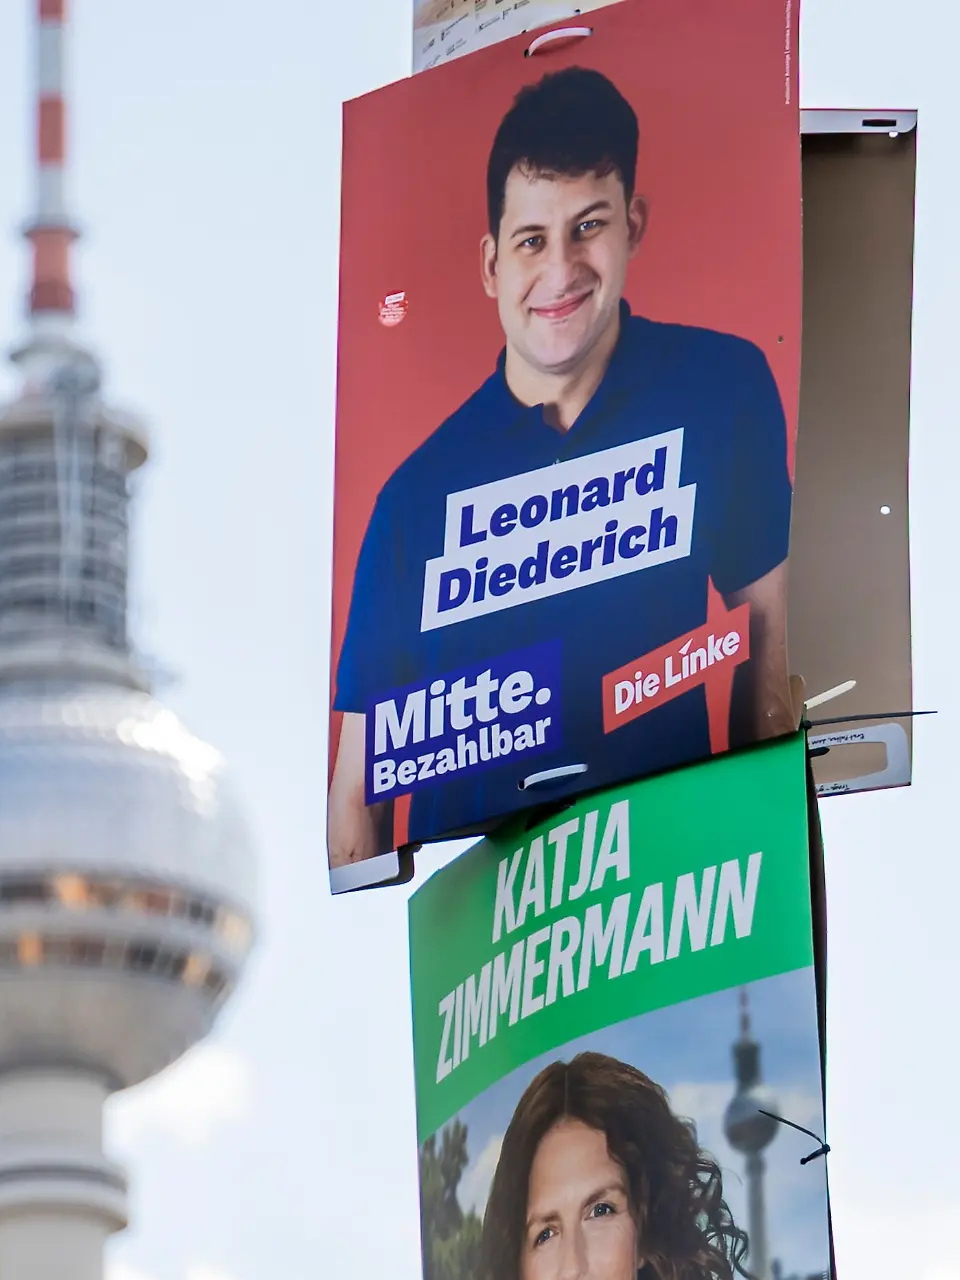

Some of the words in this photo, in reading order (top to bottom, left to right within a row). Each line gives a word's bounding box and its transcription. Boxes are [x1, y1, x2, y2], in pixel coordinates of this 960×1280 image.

[458, 446, 668, 549] Leonard
[436, 507, 678, 613] Diederich
[374, 668, 552, 756] Mitte.
[614, 670, 660, 715] Die
[664, 631, 741, 689] Linke
[373, 716, 552, 795] Bezahlbar
[492, 799, 630, 945] KATJA
[435, 851, 763, 1086] ZIMMERMANN
